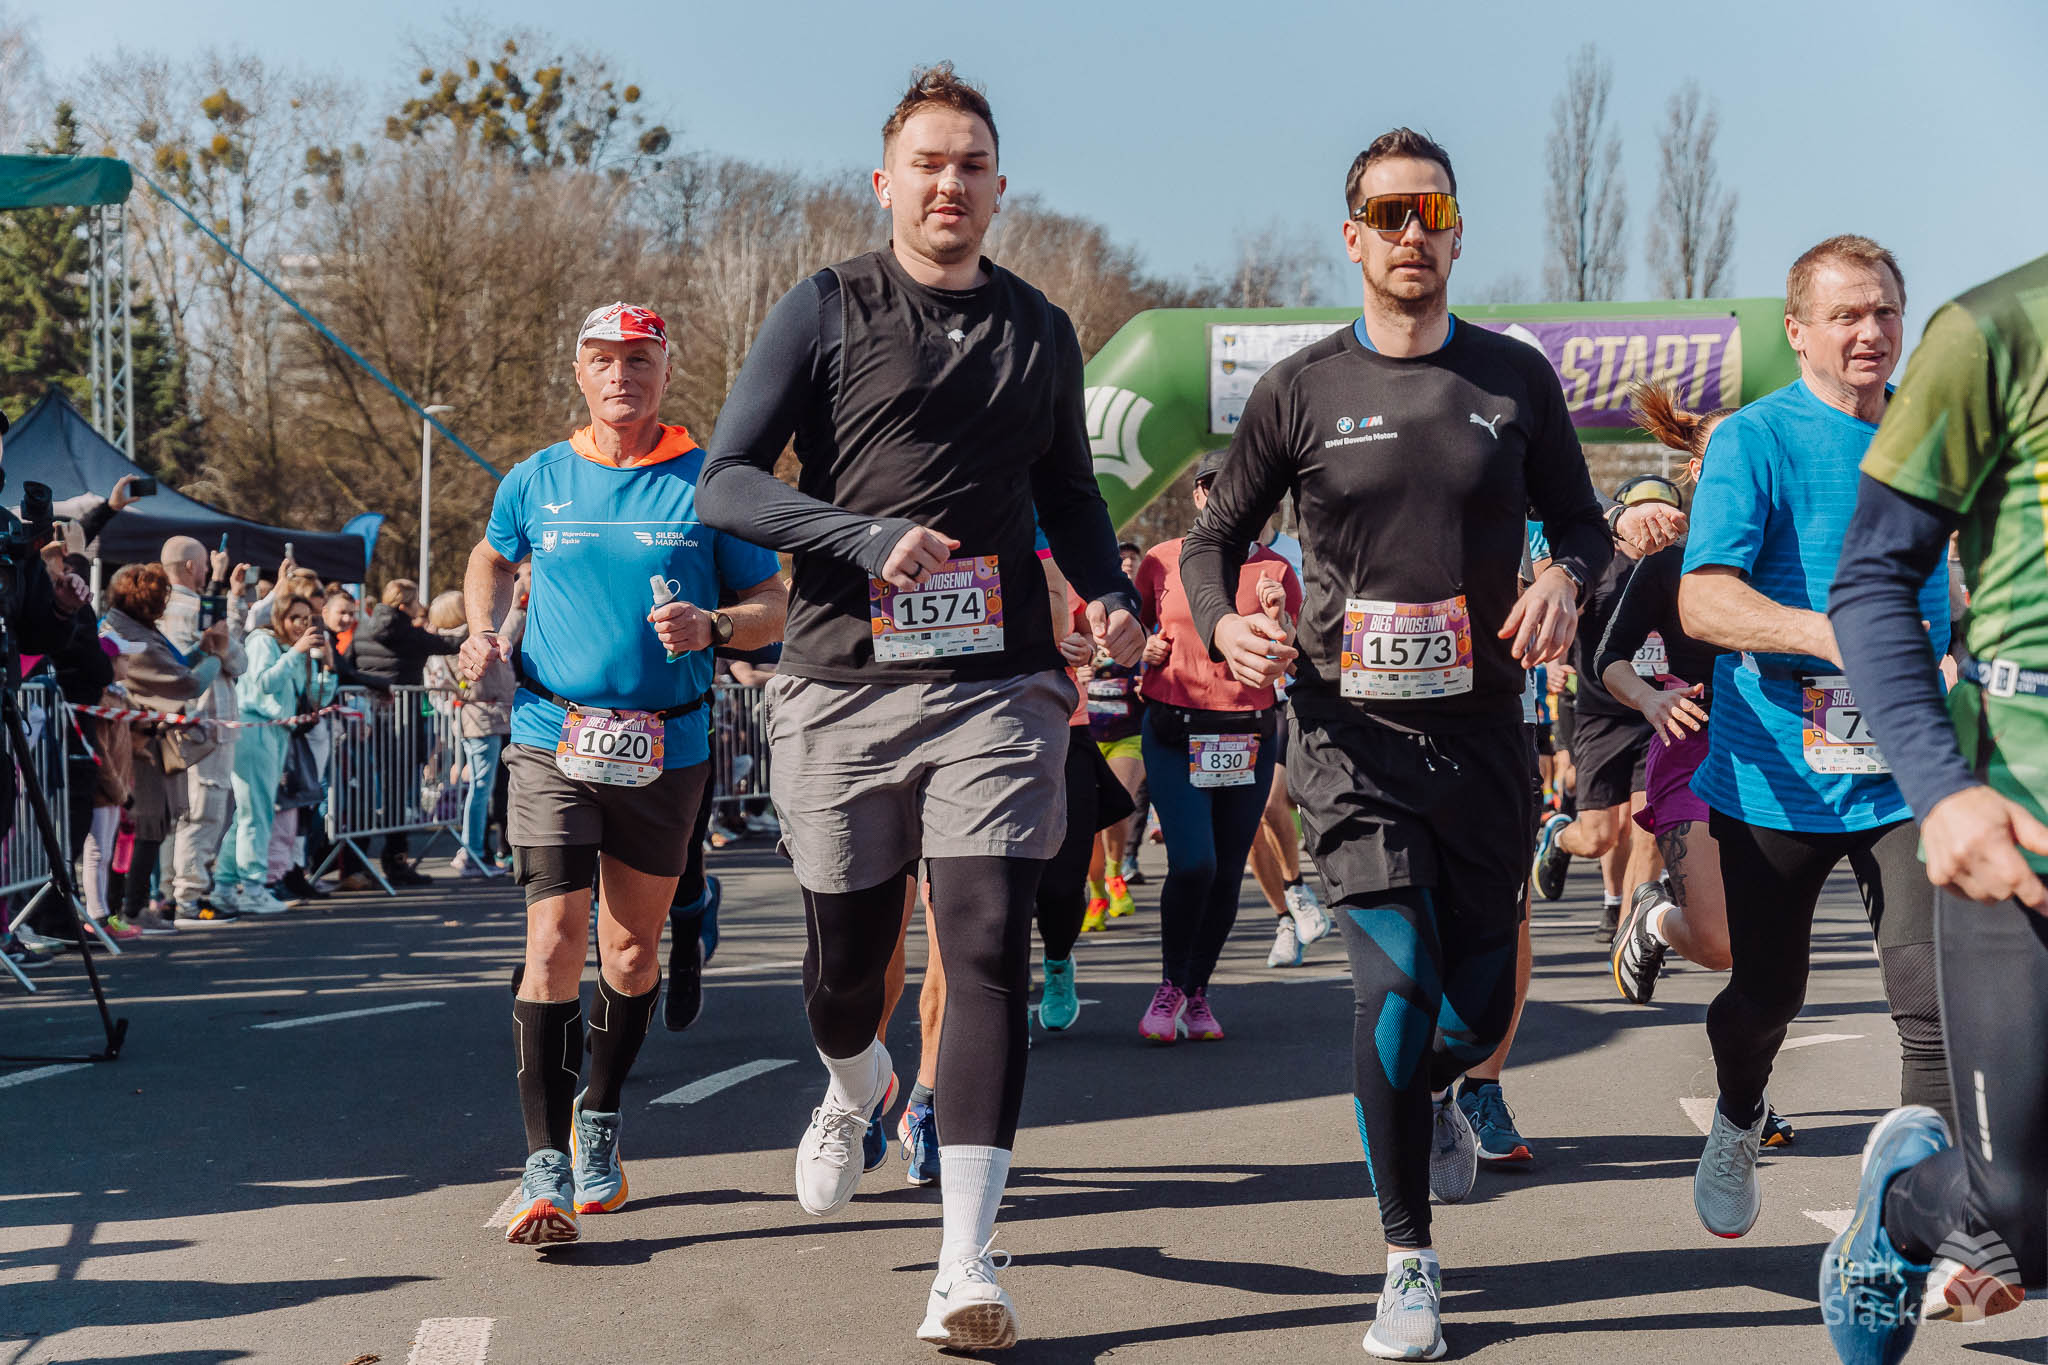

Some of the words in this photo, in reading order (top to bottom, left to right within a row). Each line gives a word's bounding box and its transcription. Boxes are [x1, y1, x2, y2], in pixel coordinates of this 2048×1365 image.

[1560, 333, 1721, 412] START
[1325, 438, 1343, 448] BMW
[1373, 432, 1398, 441] Motors
[655, 539, 699, 548] MARATHON
[656, 531, 685, 540] SILESIA
[924, 571, 974, 592] WIOSENNY
[900, 591, 980, 626] 1574
[1369, 614, 1393, 632] BIEG
[1395, 613, 1448, 633] WIOSENNY
[1369, 635, 1452, 666] 1573
[587, 716, 609, 729] BIEG
[1843, 711, 1873, 739] 7
[582, 730, 648, 760] 1020
[1211, 753, 1243, 769] 830
